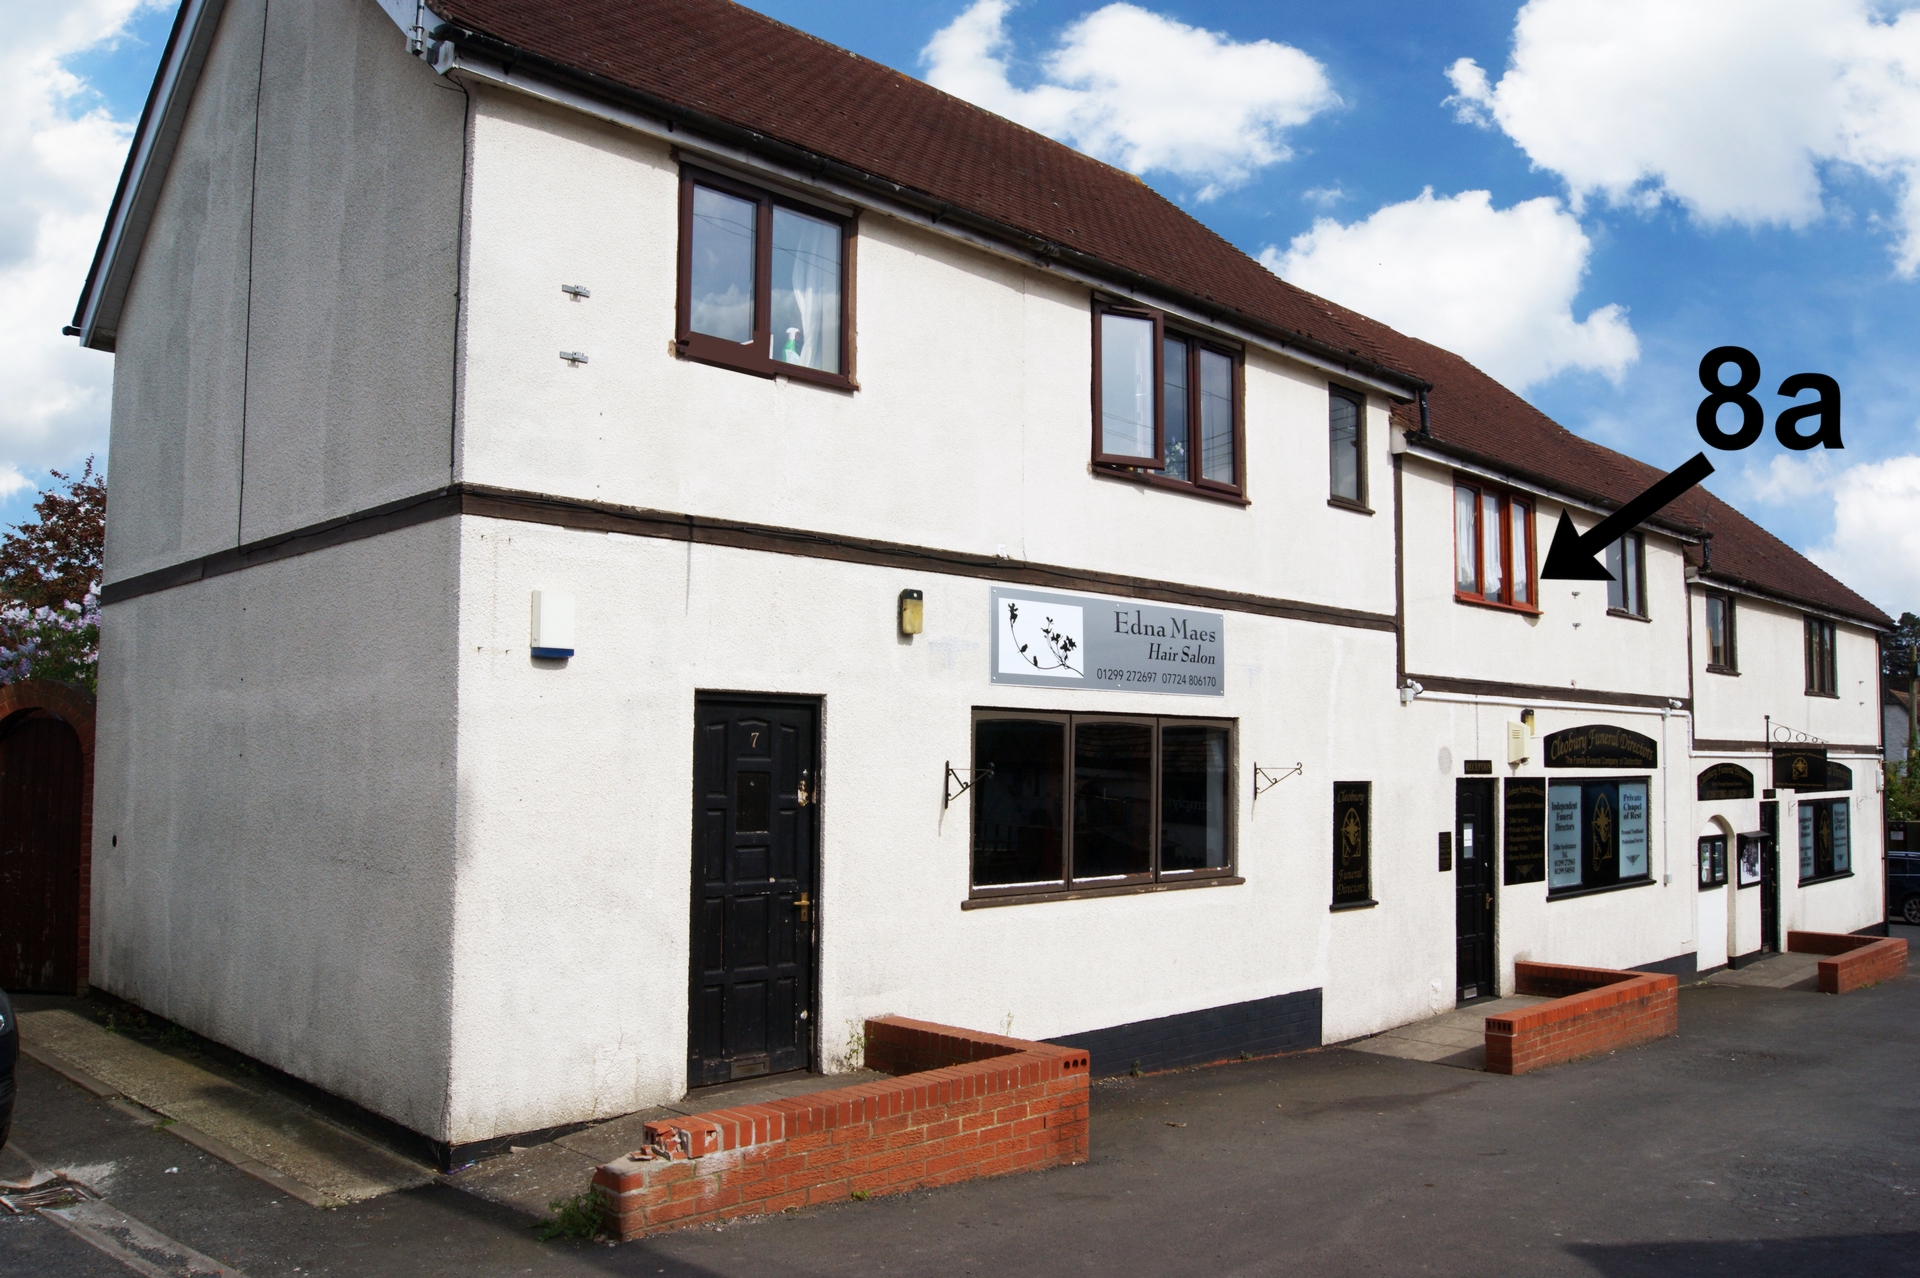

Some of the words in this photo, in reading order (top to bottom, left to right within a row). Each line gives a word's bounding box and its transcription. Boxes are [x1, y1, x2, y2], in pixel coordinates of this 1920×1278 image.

[1114, 609, 1167, 638] Edna
[1170, 617, 1217, 643] Maes
[1148, 642, 1179, 662] Hair
[1180, 644, 1216, 665] Salon
[1096, 668, 1124, 681] 01299
[1126, 670, 1158, 683] 272697
[1161, 673, 1187, 685] 07724
[1188, 674, 1217, 687] 806170
[750, 732, 760, 748] 7
[1550, 732, 1587, 760] Cleobury
[1588, 728, 1621, 750] Funeral
[1620, 733, 1654, 761] Directors
[1466, 762, 1490, 772] RECEPTION
[1565, 756, 1573, 764] The
[1574, 756, 1586, 766] Family
[1587, 756, 1601, 764] Funeral
[1602, 757, 1619, 766] Company
[1337, 790, 1365, 806] Cleobury
[1552, 802, 1578, 812] Independent
[1623, 802, 1642, 812] Chapel
[1556, 812, 1573, 821] Funeral
[1623, 812, 1630, 820] of
[1555, 823, 1575, 832] Directors
[1338, 866, 1363, 882] Funeral
[1336, 882, 1366, 894] Directors
